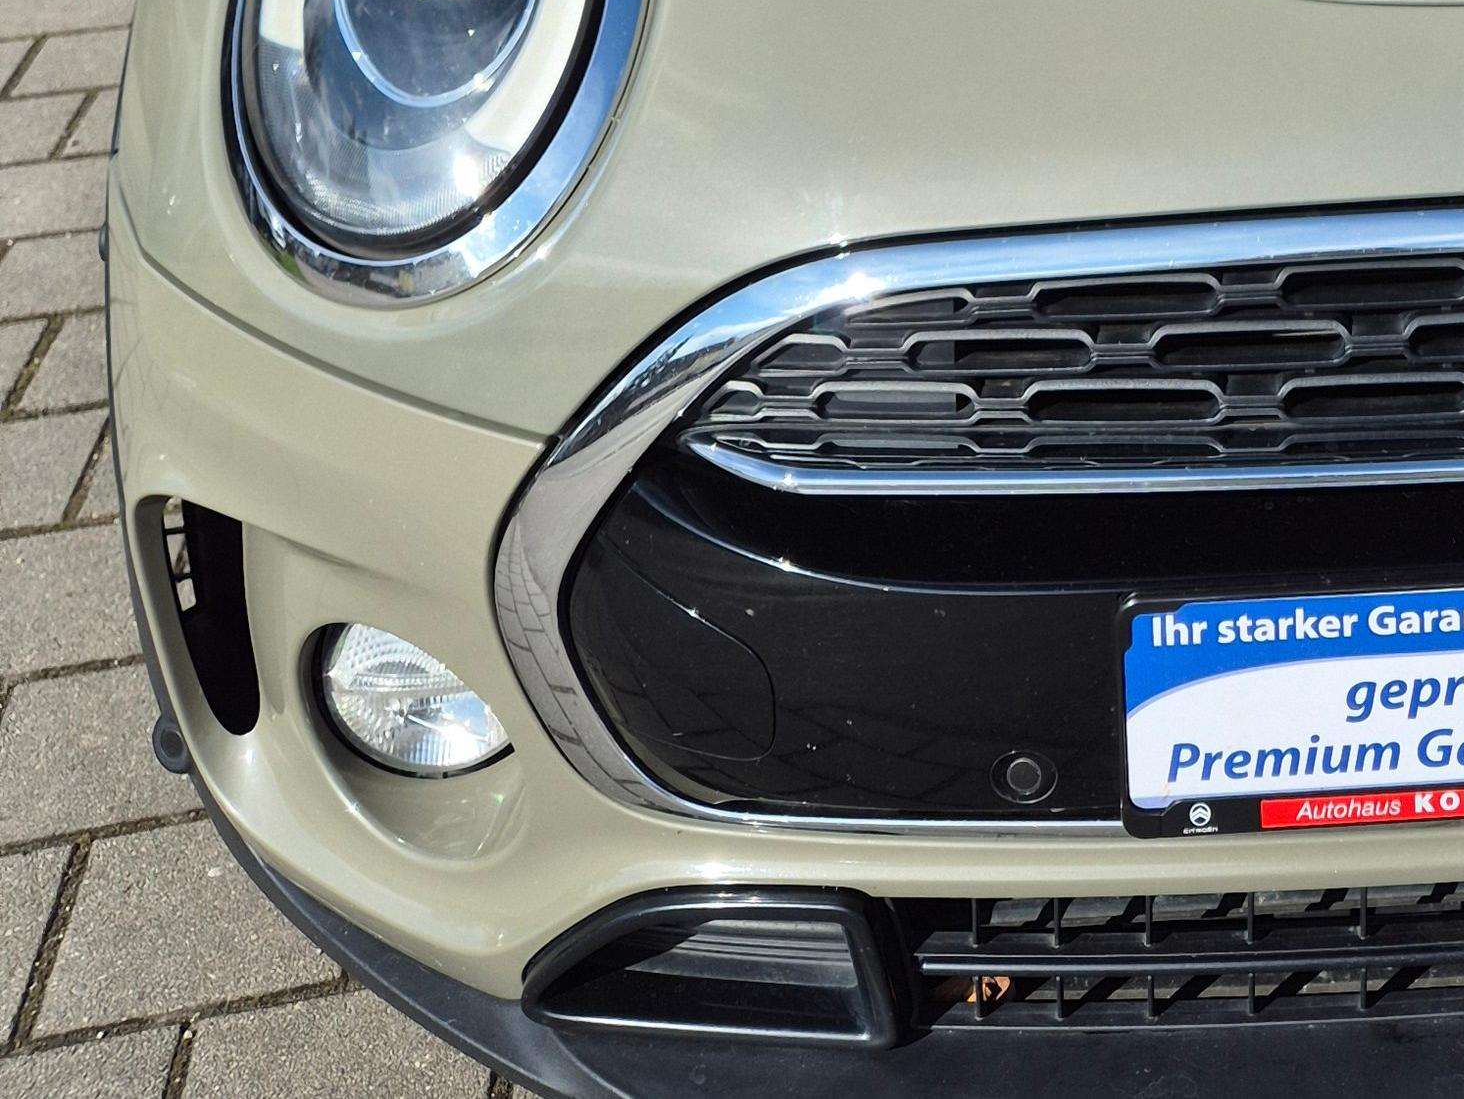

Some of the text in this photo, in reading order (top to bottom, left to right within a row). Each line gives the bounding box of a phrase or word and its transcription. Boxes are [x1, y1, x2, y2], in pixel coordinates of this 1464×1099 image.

[1151, 613, 1208, 647] Ihr
[1217, 607, 1359, 644] starker
[1167, 734, 1401, 783] Premium
[1295, 796, 1402, 821] Autohaus
